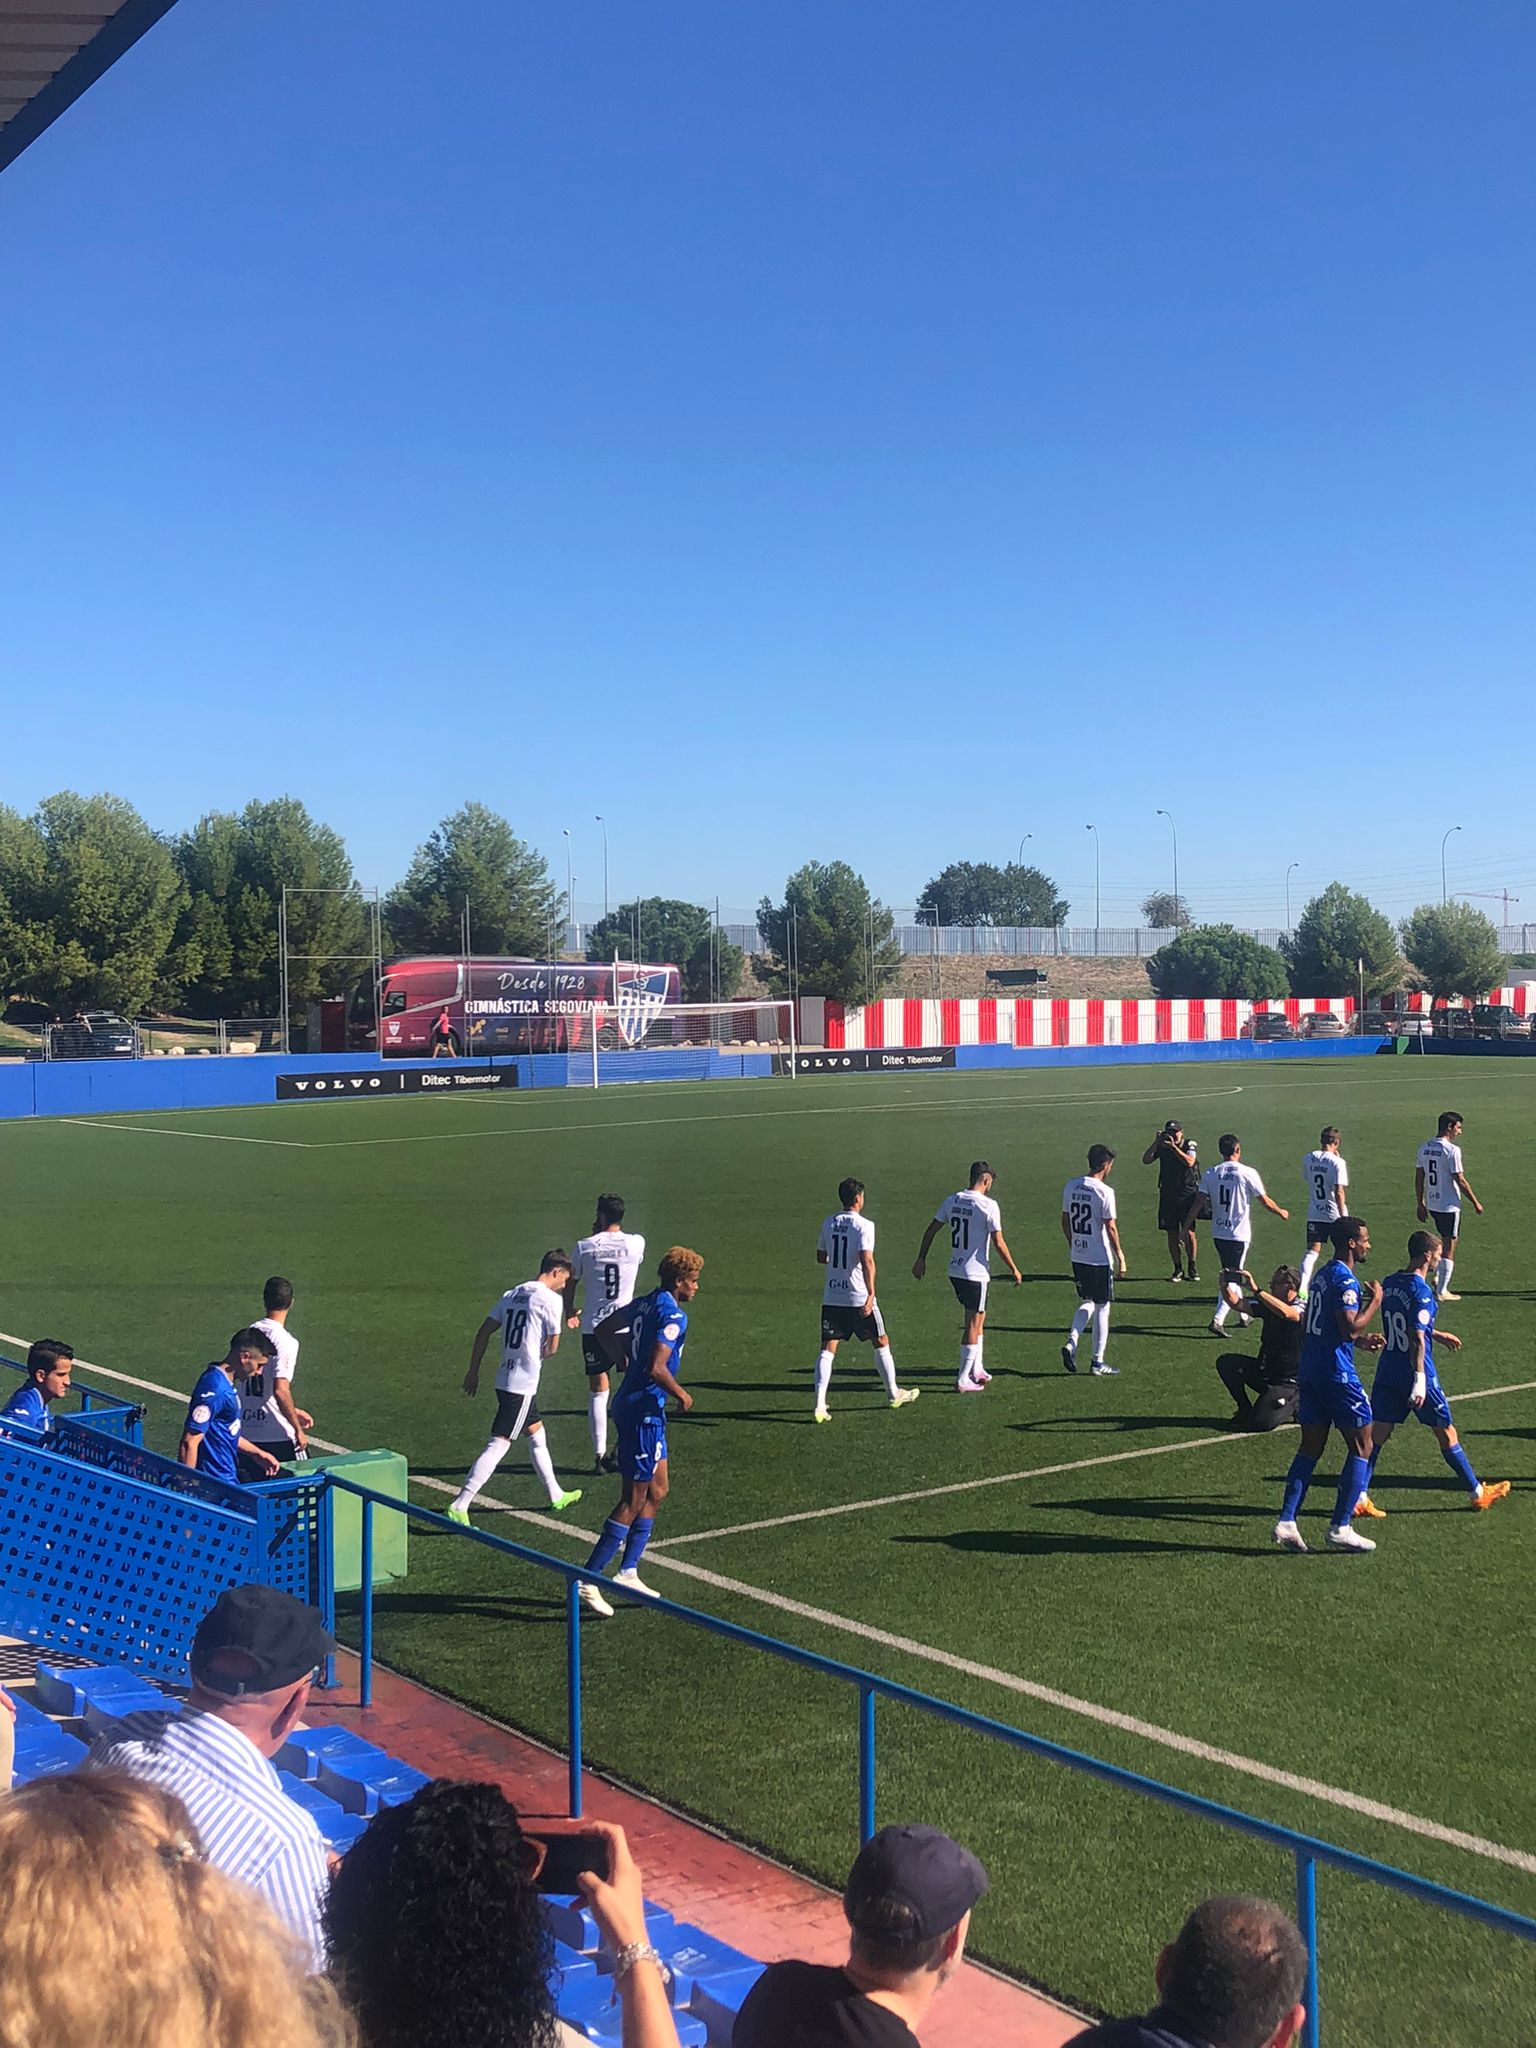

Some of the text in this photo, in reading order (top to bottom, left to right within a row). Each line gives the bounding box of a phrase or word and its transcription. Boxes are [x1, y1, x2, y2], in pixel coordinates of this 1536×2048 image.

[497, 971, 586, 993] Desde 1928
[464, 997, 539, 1014] GIMNÁSTICA
[882, 1055, 943, 1066] Ditec Tibermotor
[295, 1078, 381, 1091] VOLVO
[422, 1074, 451, 1086] Ditec
[1314, 1174, 1326, 1200] 3
[1428, 1159, 1438, 1187] 5
[1219, 1184, 1230, 1213] 4
[951, 1216, 969, 1250] 21
[1070, 1202, 1092, 1235] 22
[832, 1234, 848, 1269] 11
[605, 1263, 620, 1299] 9
[1305, 1290, 1323, 1336] 12
[505, 1308, 527, 1349] 18
[1384, 1310, 1410, 1352] 18
